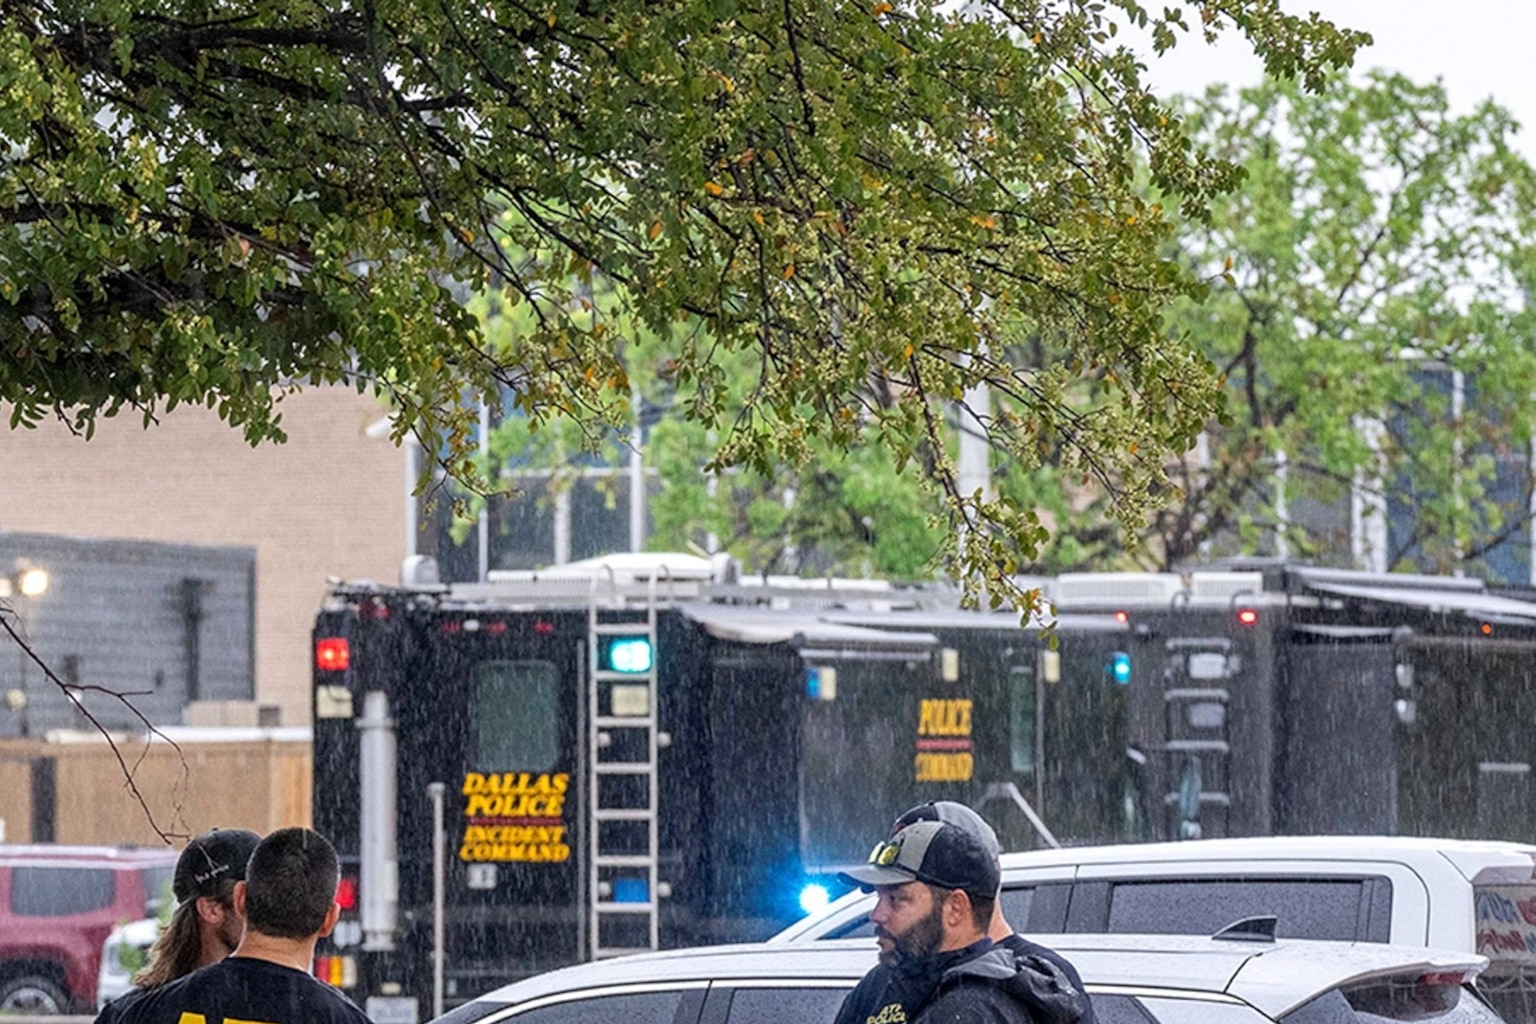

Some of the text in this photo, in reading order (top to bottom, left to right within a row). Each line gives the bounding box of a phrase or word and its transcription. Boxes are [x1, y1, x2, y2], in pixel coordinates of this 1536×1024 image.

[917, 698, 973, 736] POLICE
[462, 771, 570, 795] DALLAS
[465, 794, 565, 817] POLICE
[463, 825, 566, 843] INCIDENT
[459, 842, 571, 862] COMMAND
